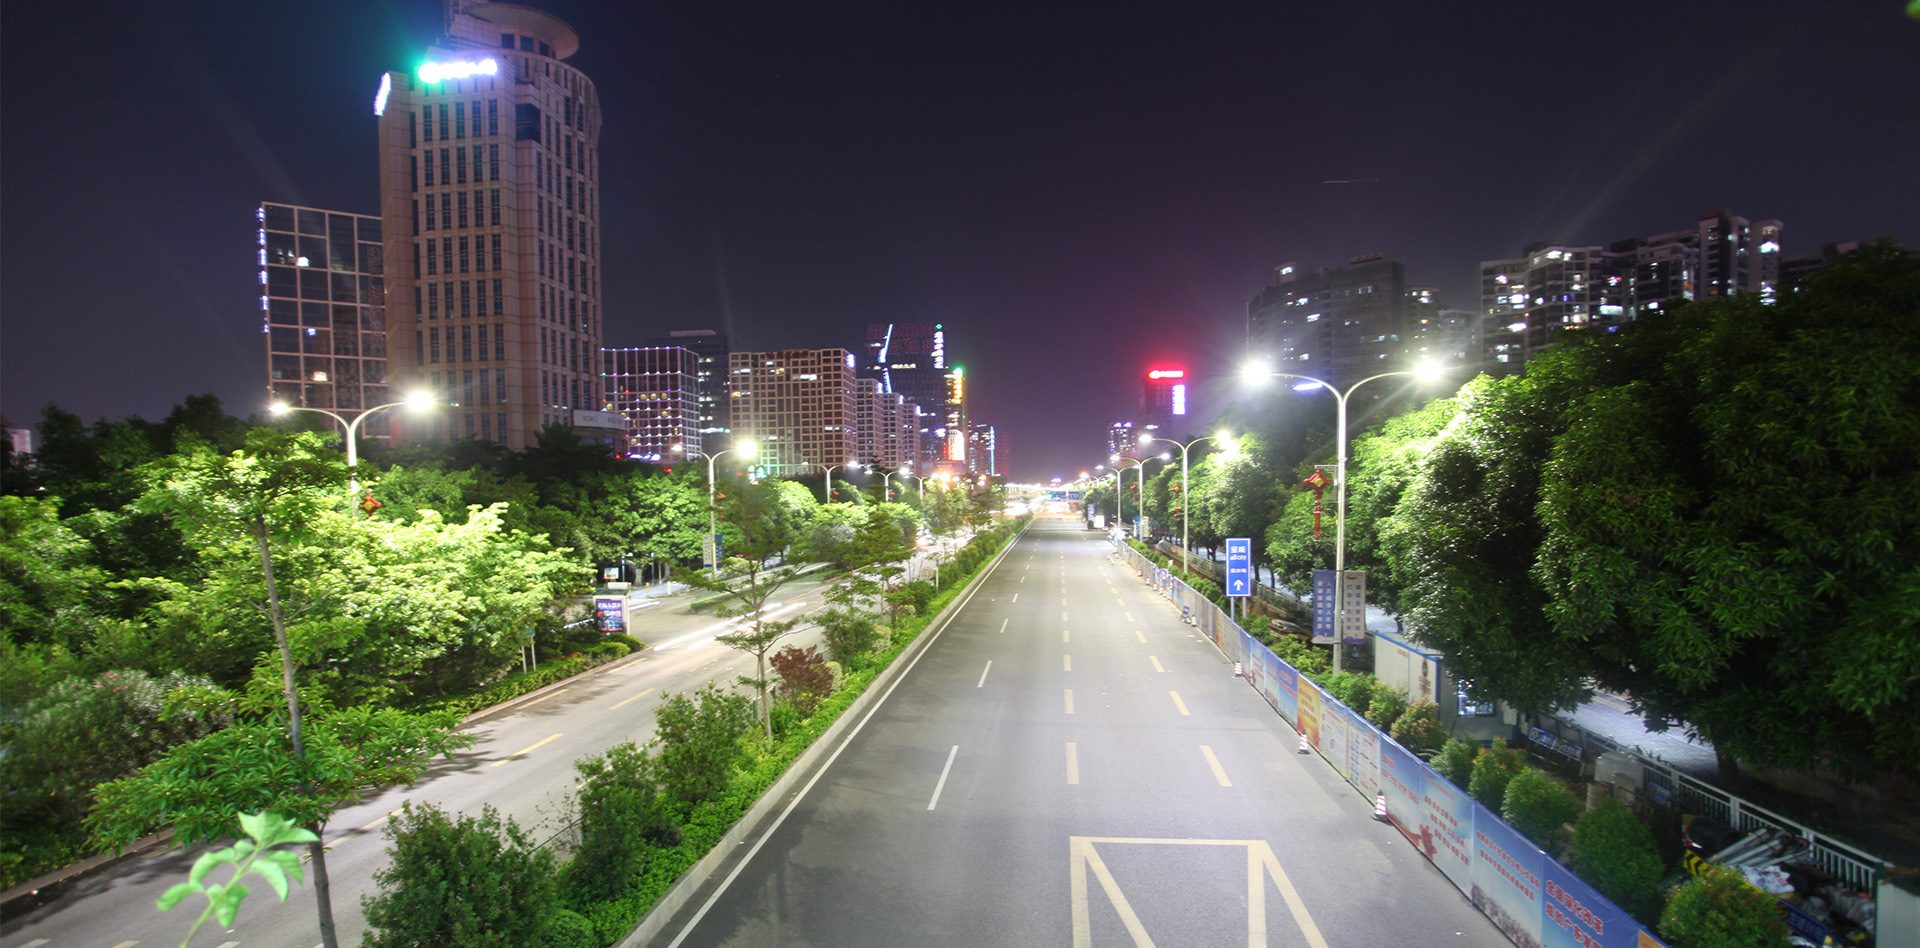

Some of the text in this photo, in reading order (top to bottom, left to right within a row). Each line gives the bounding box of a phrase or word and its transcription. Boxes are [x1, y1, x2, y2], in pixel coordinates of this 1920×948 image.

[1545, 879, 1604, 935] 全面深化改革
